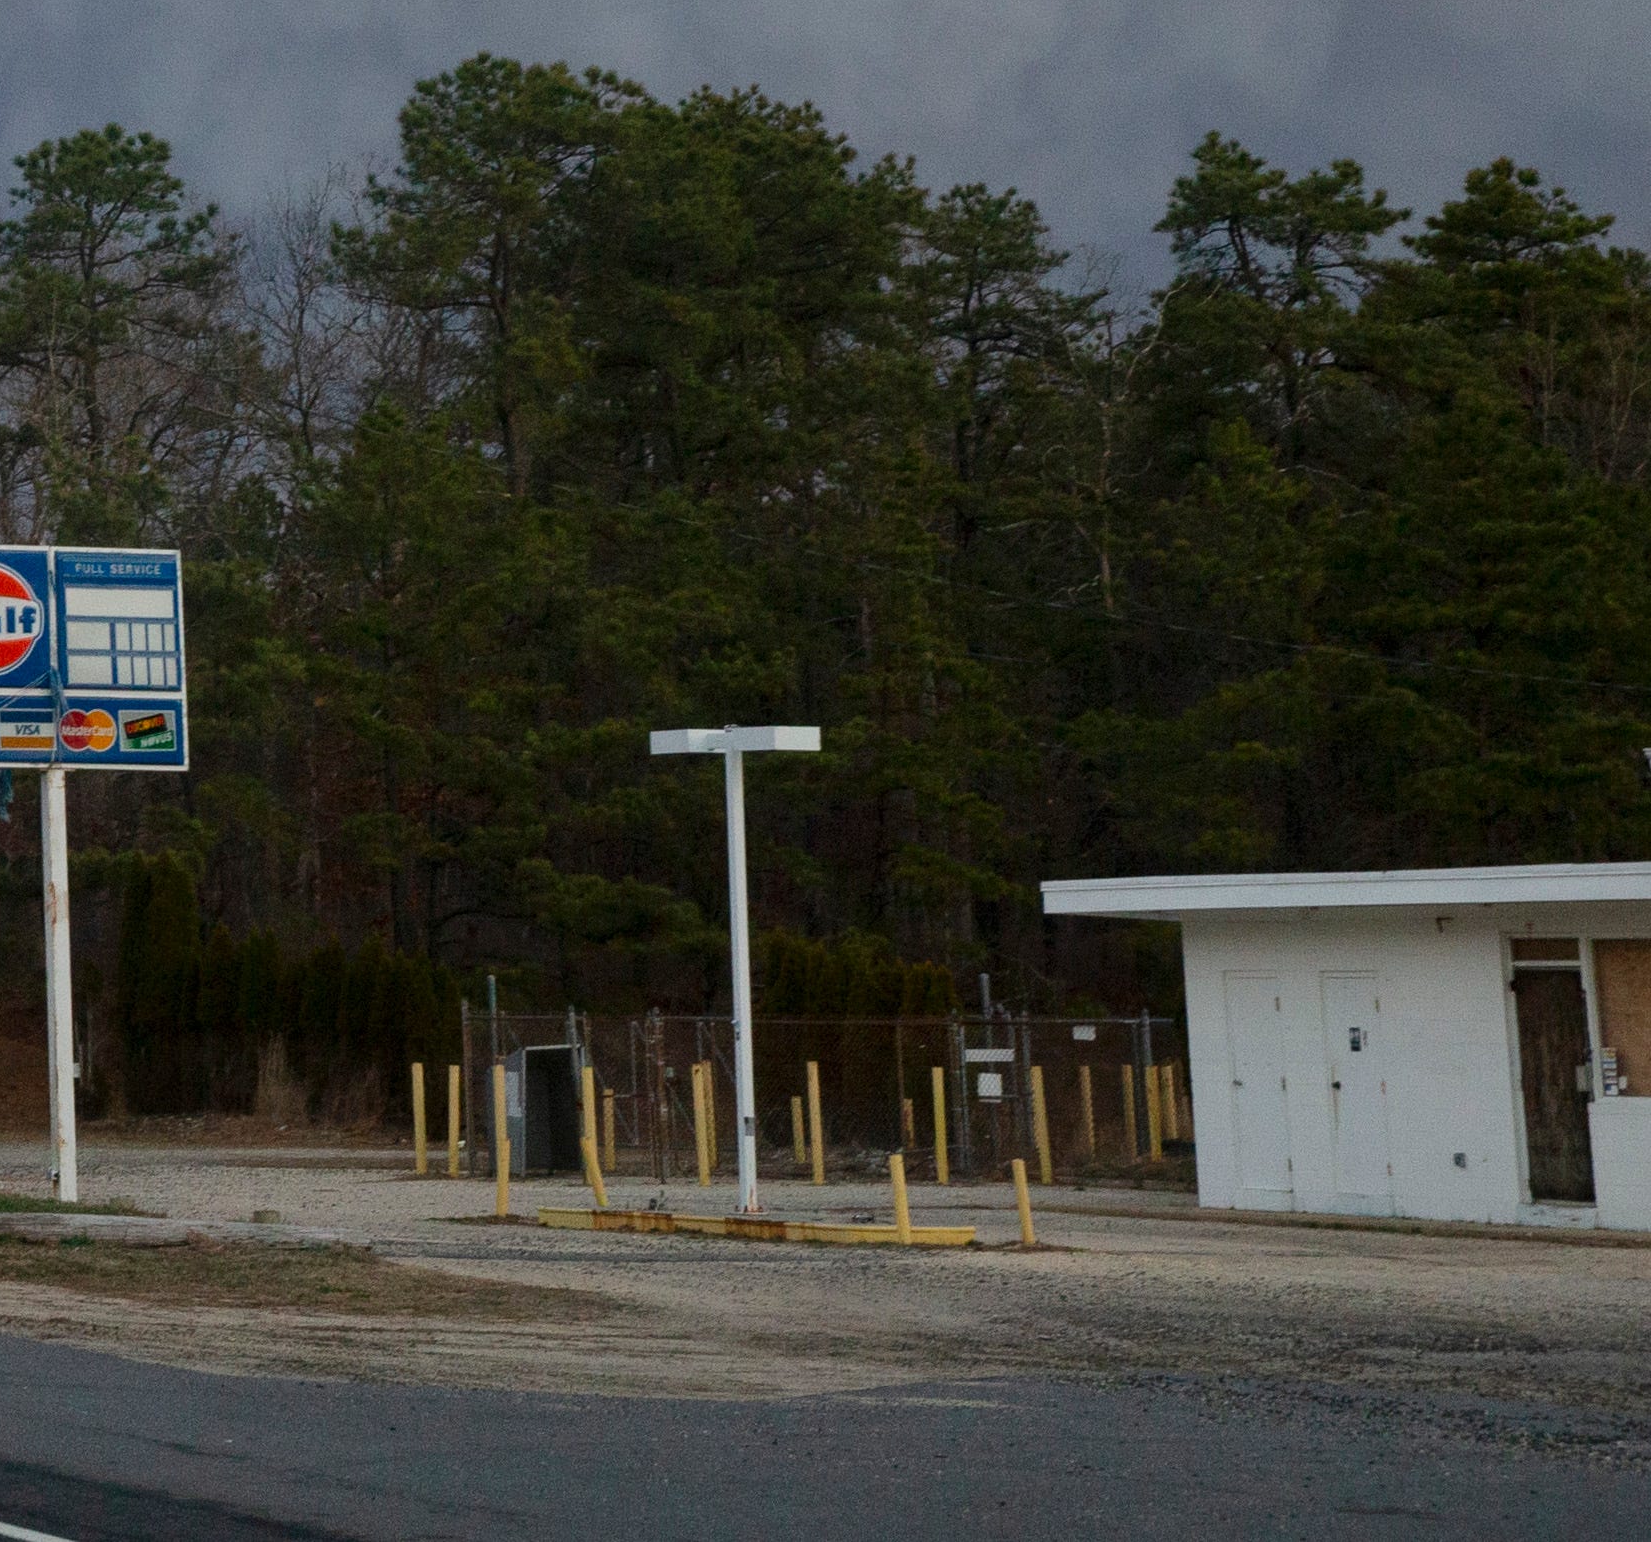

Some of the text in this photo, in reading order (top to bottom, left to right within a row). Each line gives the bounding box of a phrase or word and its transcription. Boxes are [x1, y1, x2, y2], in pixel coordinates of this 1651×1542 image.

[74, 563, 162, 575] FULL SERVICE
[15, 724, 41, 735] VISA
[62, 725, 114, 737] MasterCard
